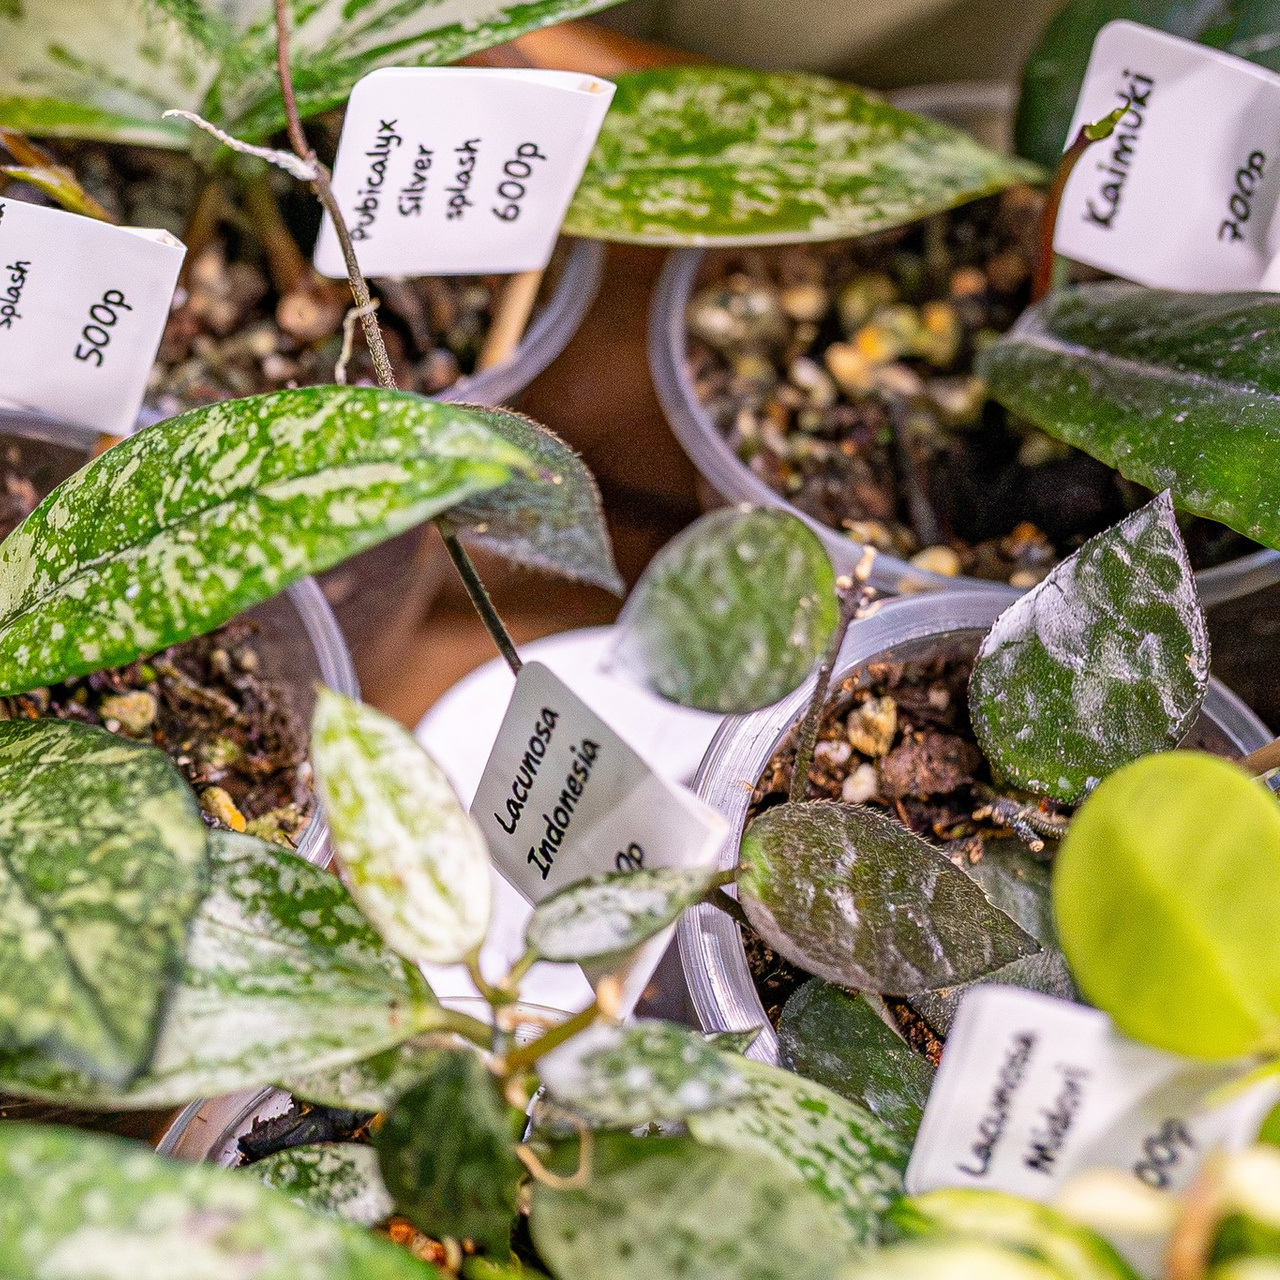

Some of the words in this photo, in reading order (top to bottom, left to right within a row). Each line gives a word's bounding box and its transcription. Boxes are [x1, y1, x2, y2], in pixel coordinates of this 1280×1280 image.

[353, 119, 403, 243] Pubicalyx
[399, 144, 434, 217] Silver
[493, 706, 560, 836] Lacunosa
[526, 738, 602, 881] Indonesia
